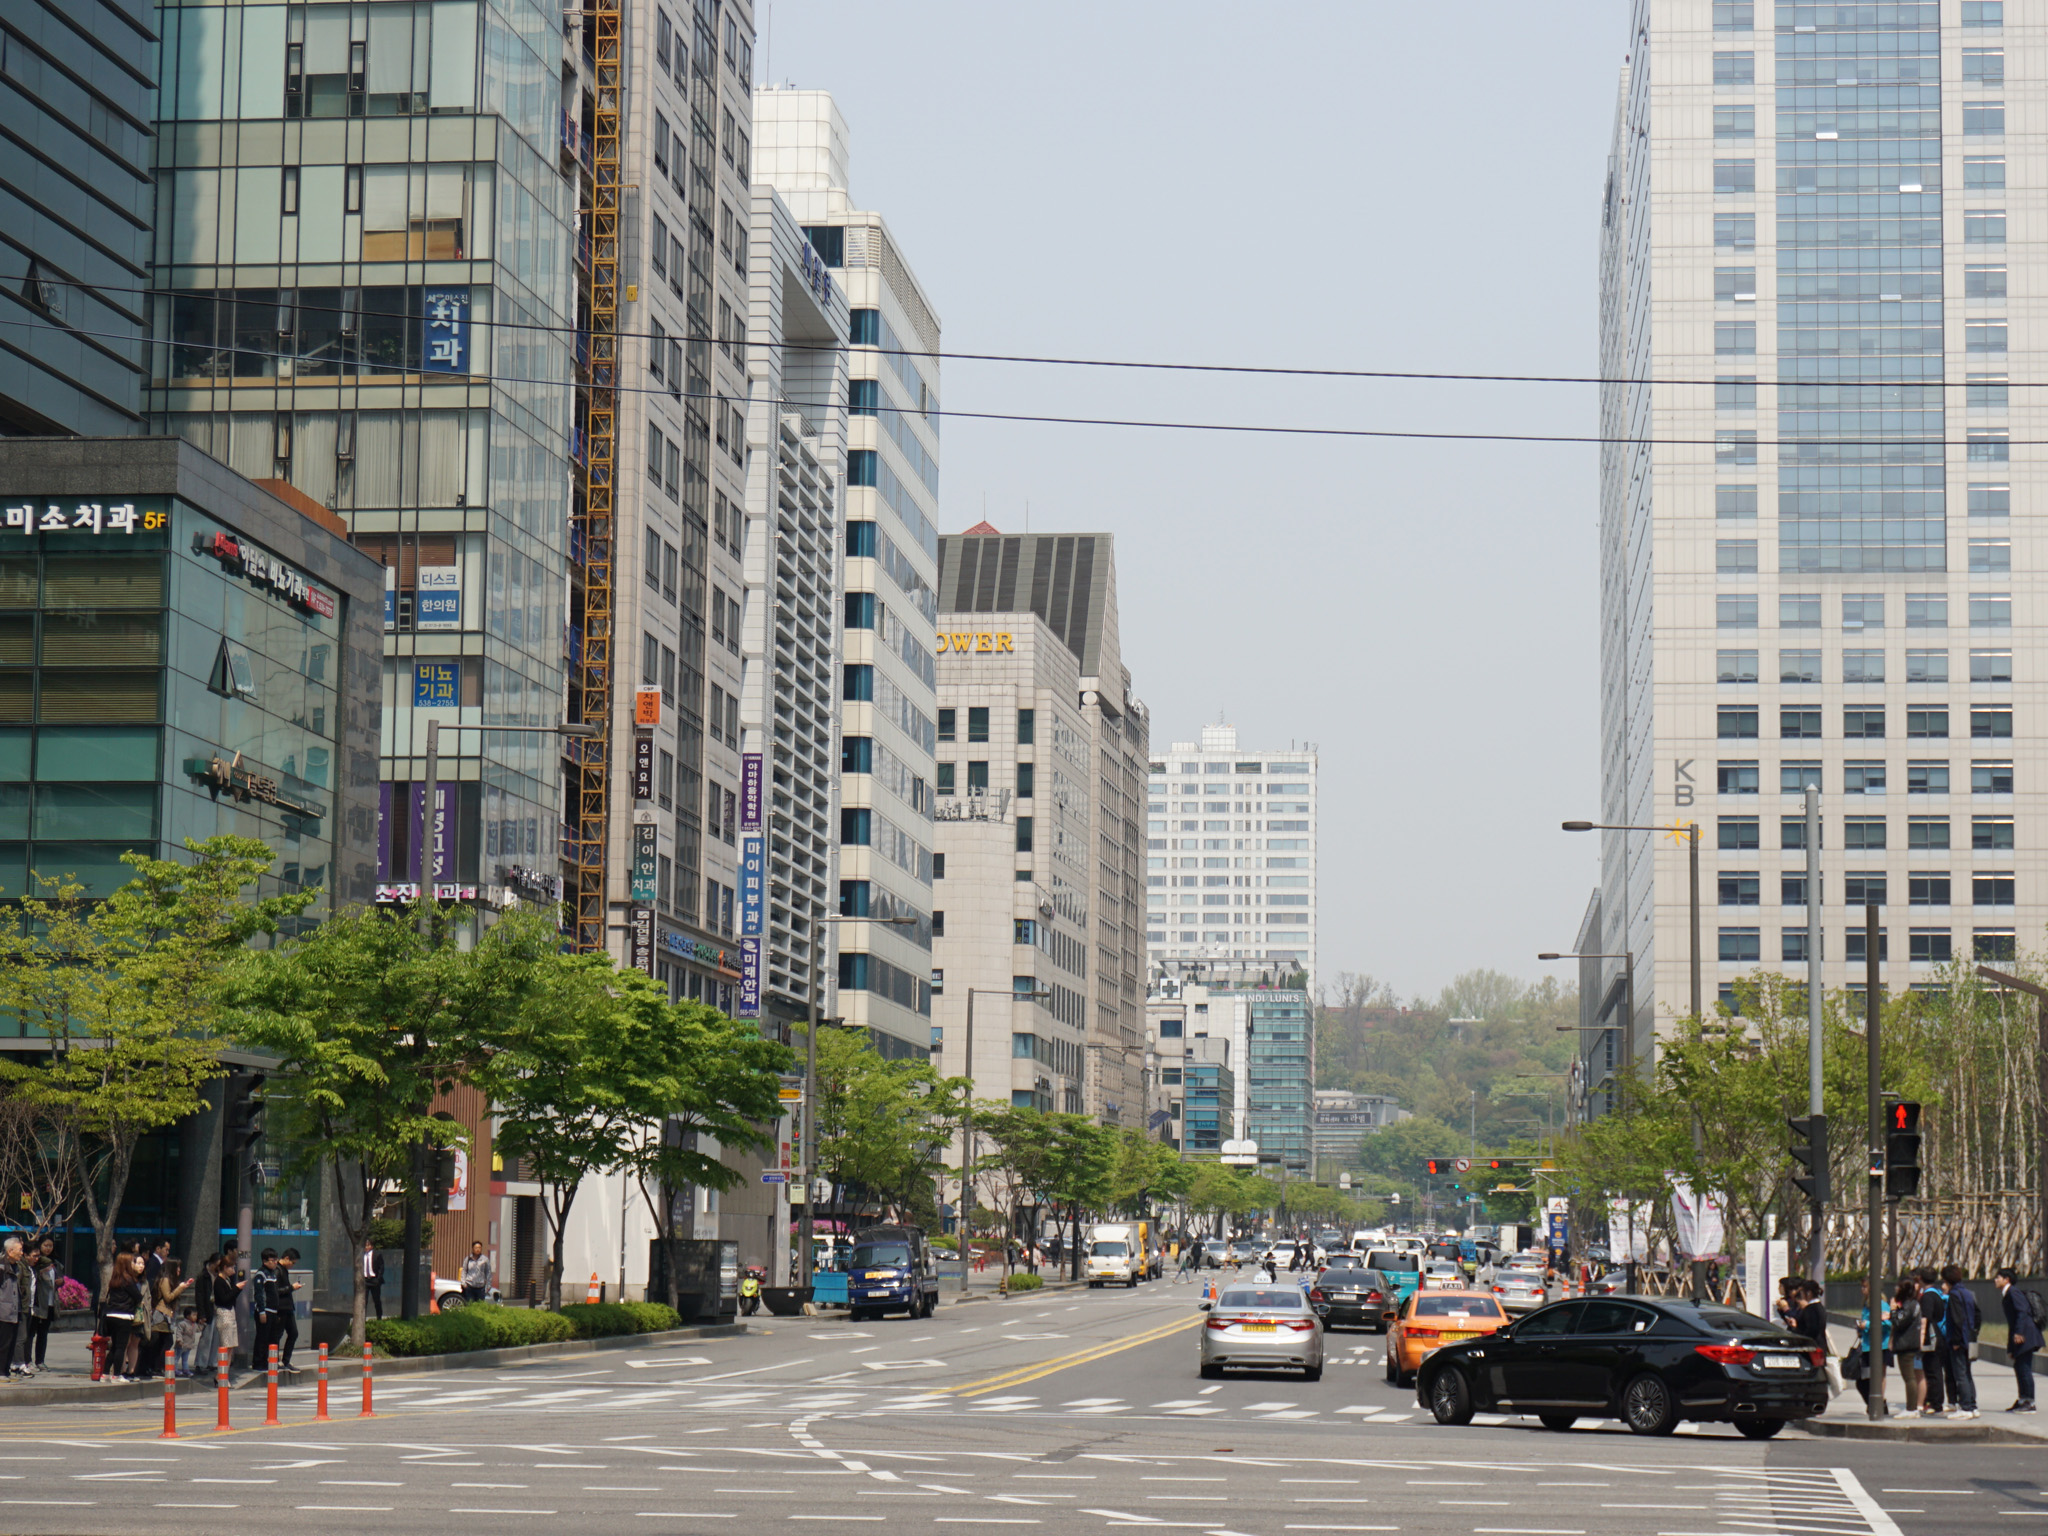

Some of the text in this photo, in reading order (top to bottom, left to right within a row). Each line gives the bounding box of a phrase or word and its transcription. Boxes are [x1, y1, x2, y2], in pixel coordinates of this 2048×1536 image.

[430, 306, 462, 367] 치과
[0, 504, 166, 535] 미소치과 5F
[422, 573, 457, 586] 디스크
[421, 599, 457, 612] 한의원
[936, 632, 1014, 652] OWER
[419, 684, 454, 699] 기과
[420, 666, 453, 682] 비뇨
[638, 744, 649, 797] 오앤요가
[1675, 759, 1696, 807] KB
[641, 826, 655, 876] 김이안
[746, 842, 760, 924] 마이피부과
[743, 953, 758, 1005] 미래안과
